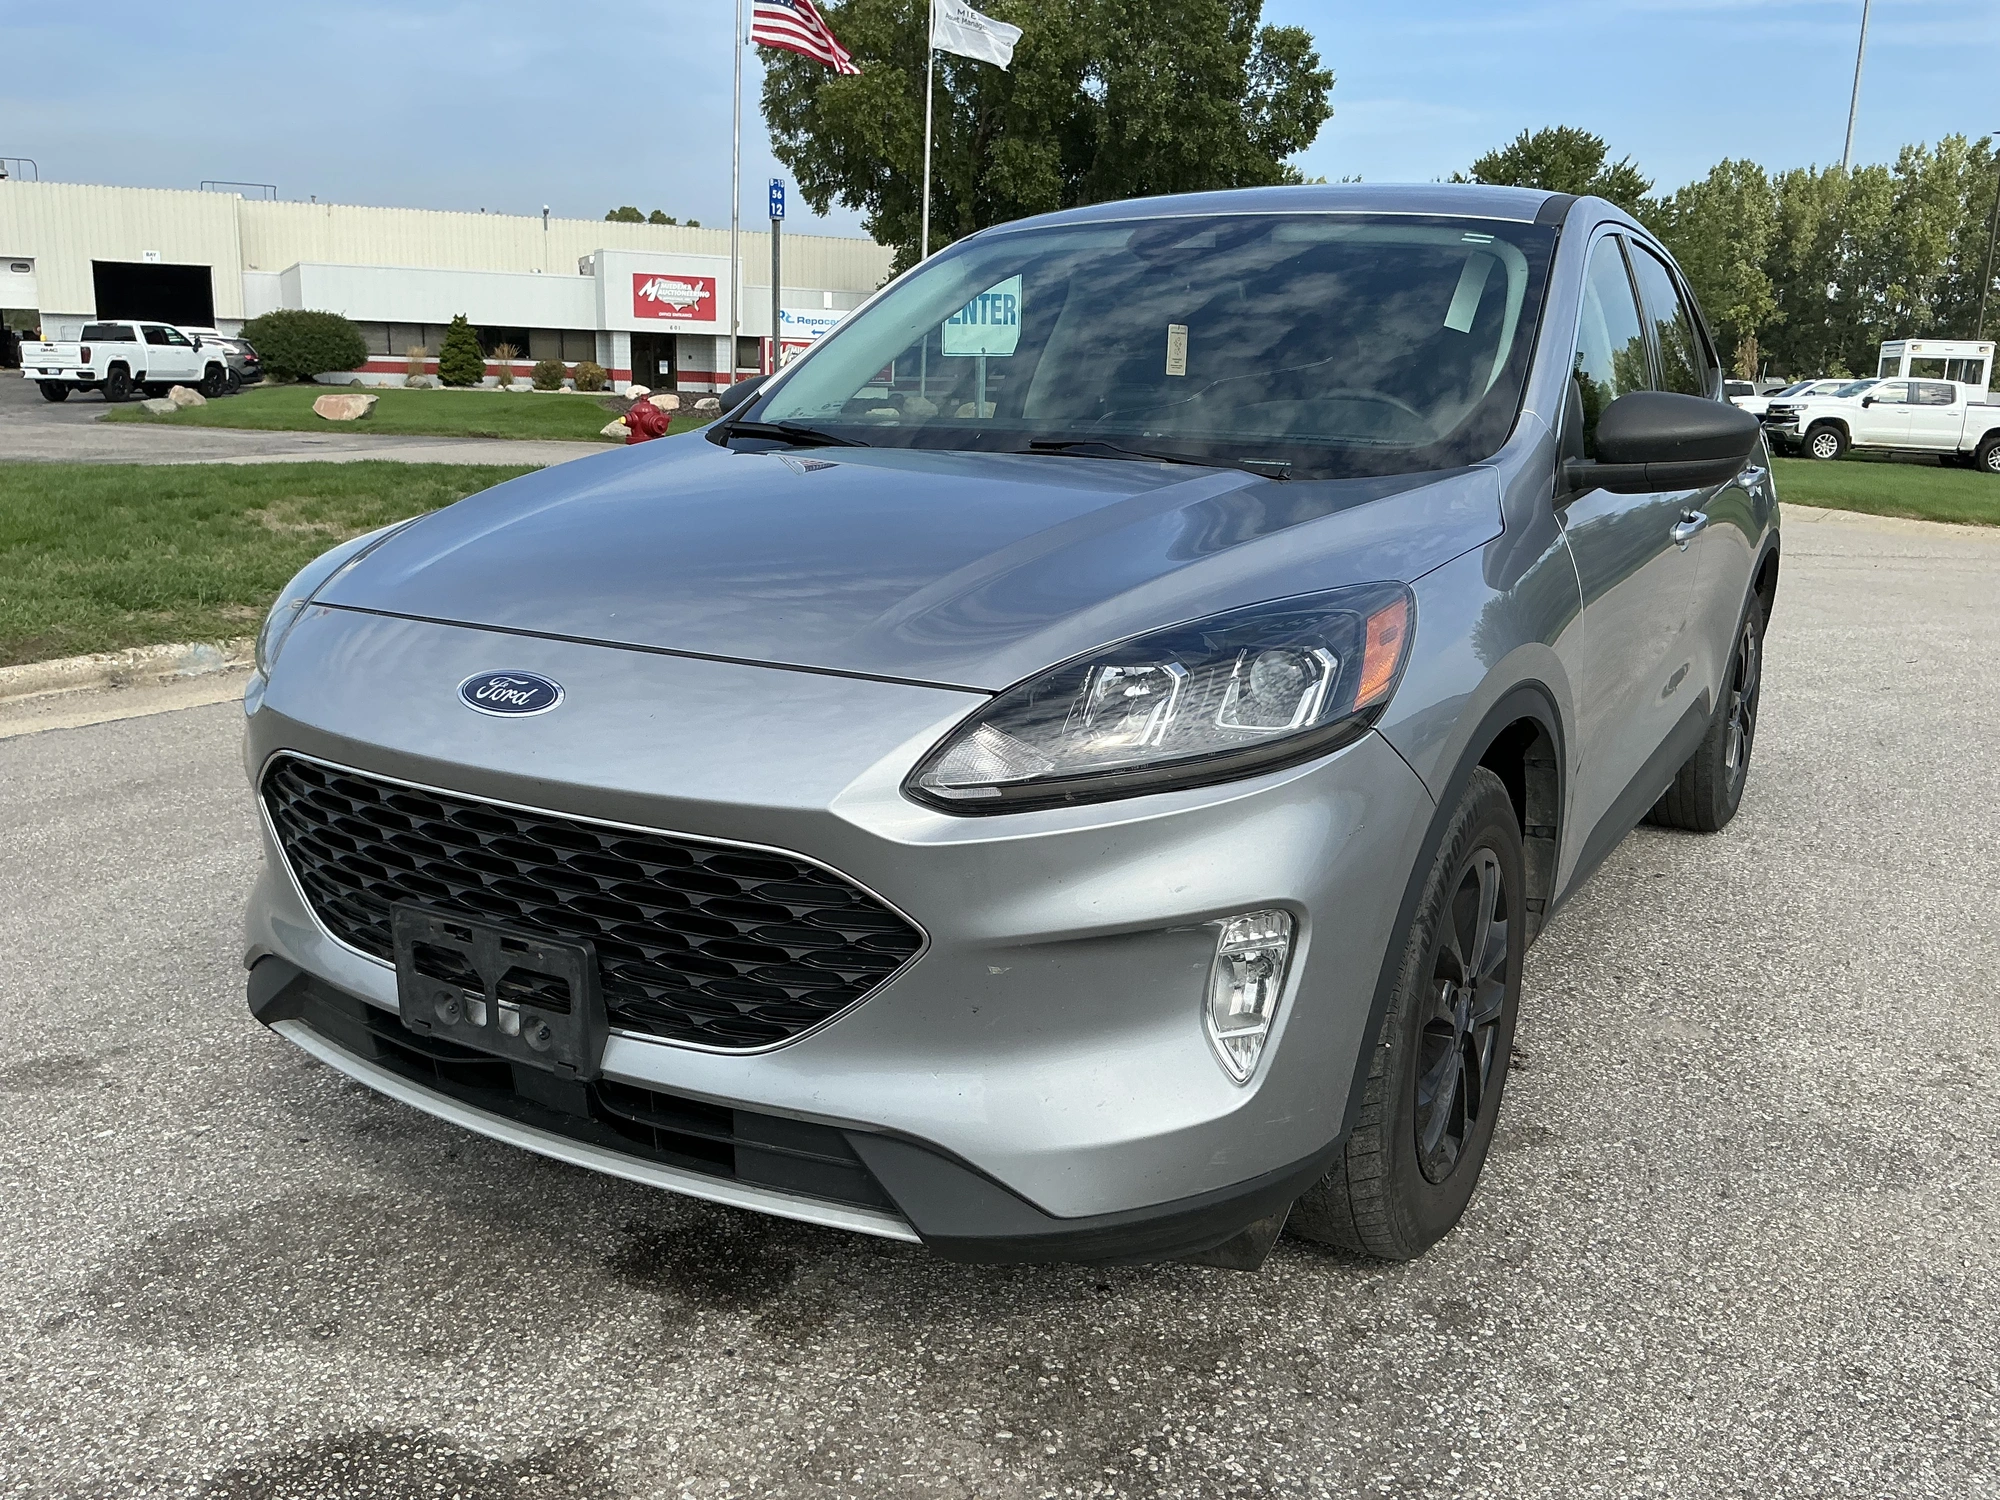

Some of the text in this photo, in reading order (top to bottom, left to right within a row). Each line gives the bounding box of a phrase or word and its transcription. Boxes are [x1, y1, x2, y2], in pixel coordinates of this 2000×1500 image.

[772, 189, 782, 199] 56
[771, 202, 783, 215] 12
[658, 289, 710, 298] AUCTIONEERING
[476, 676, 538, 706] Ford
[1419, 802, 1480, 955] UNIROYAL
